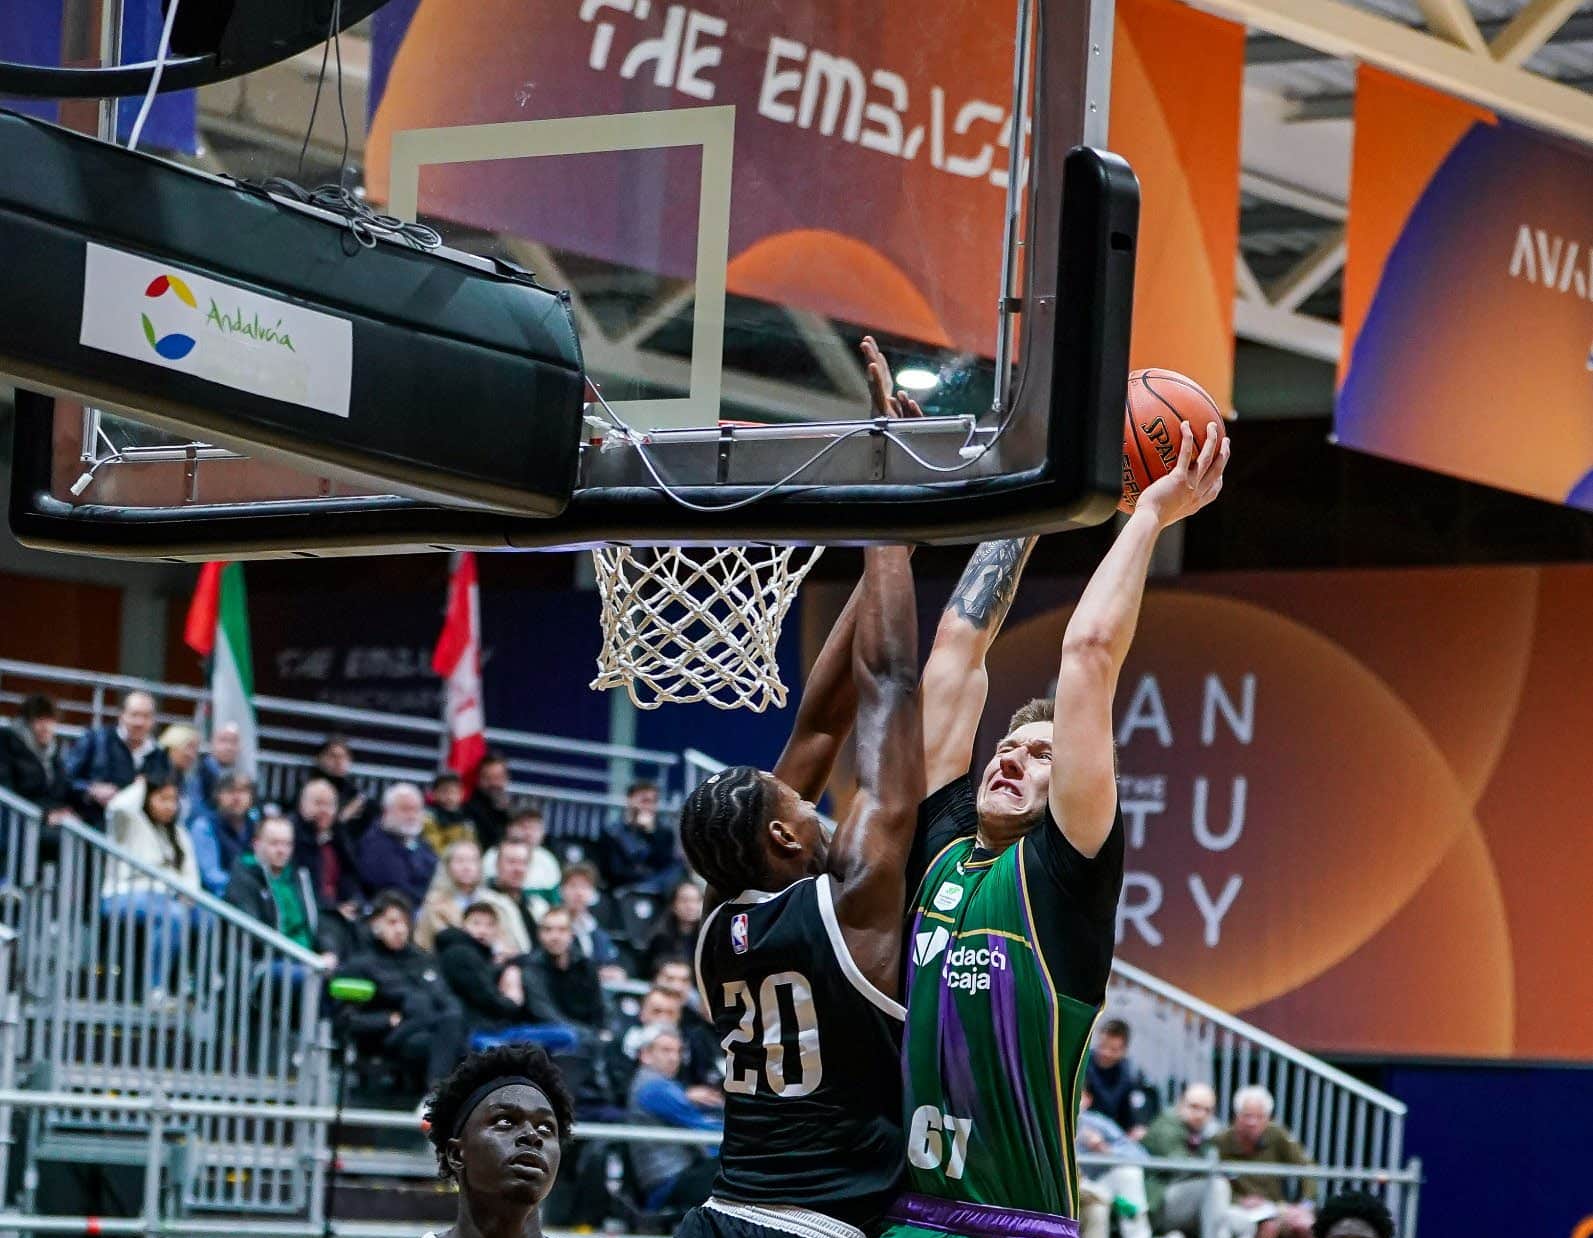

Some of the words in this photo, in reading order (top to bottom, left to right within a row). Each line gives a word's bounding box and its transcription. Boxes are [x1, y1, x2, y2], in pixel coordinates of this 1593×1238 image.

[579, 0, 728, 101] THE
[206, 296, 296, 353] Andalucía
[1117, 672, 1257, 747] AN
[720, 971, 823, 1097] 20
[908, 1104, 972, 1180] 67
